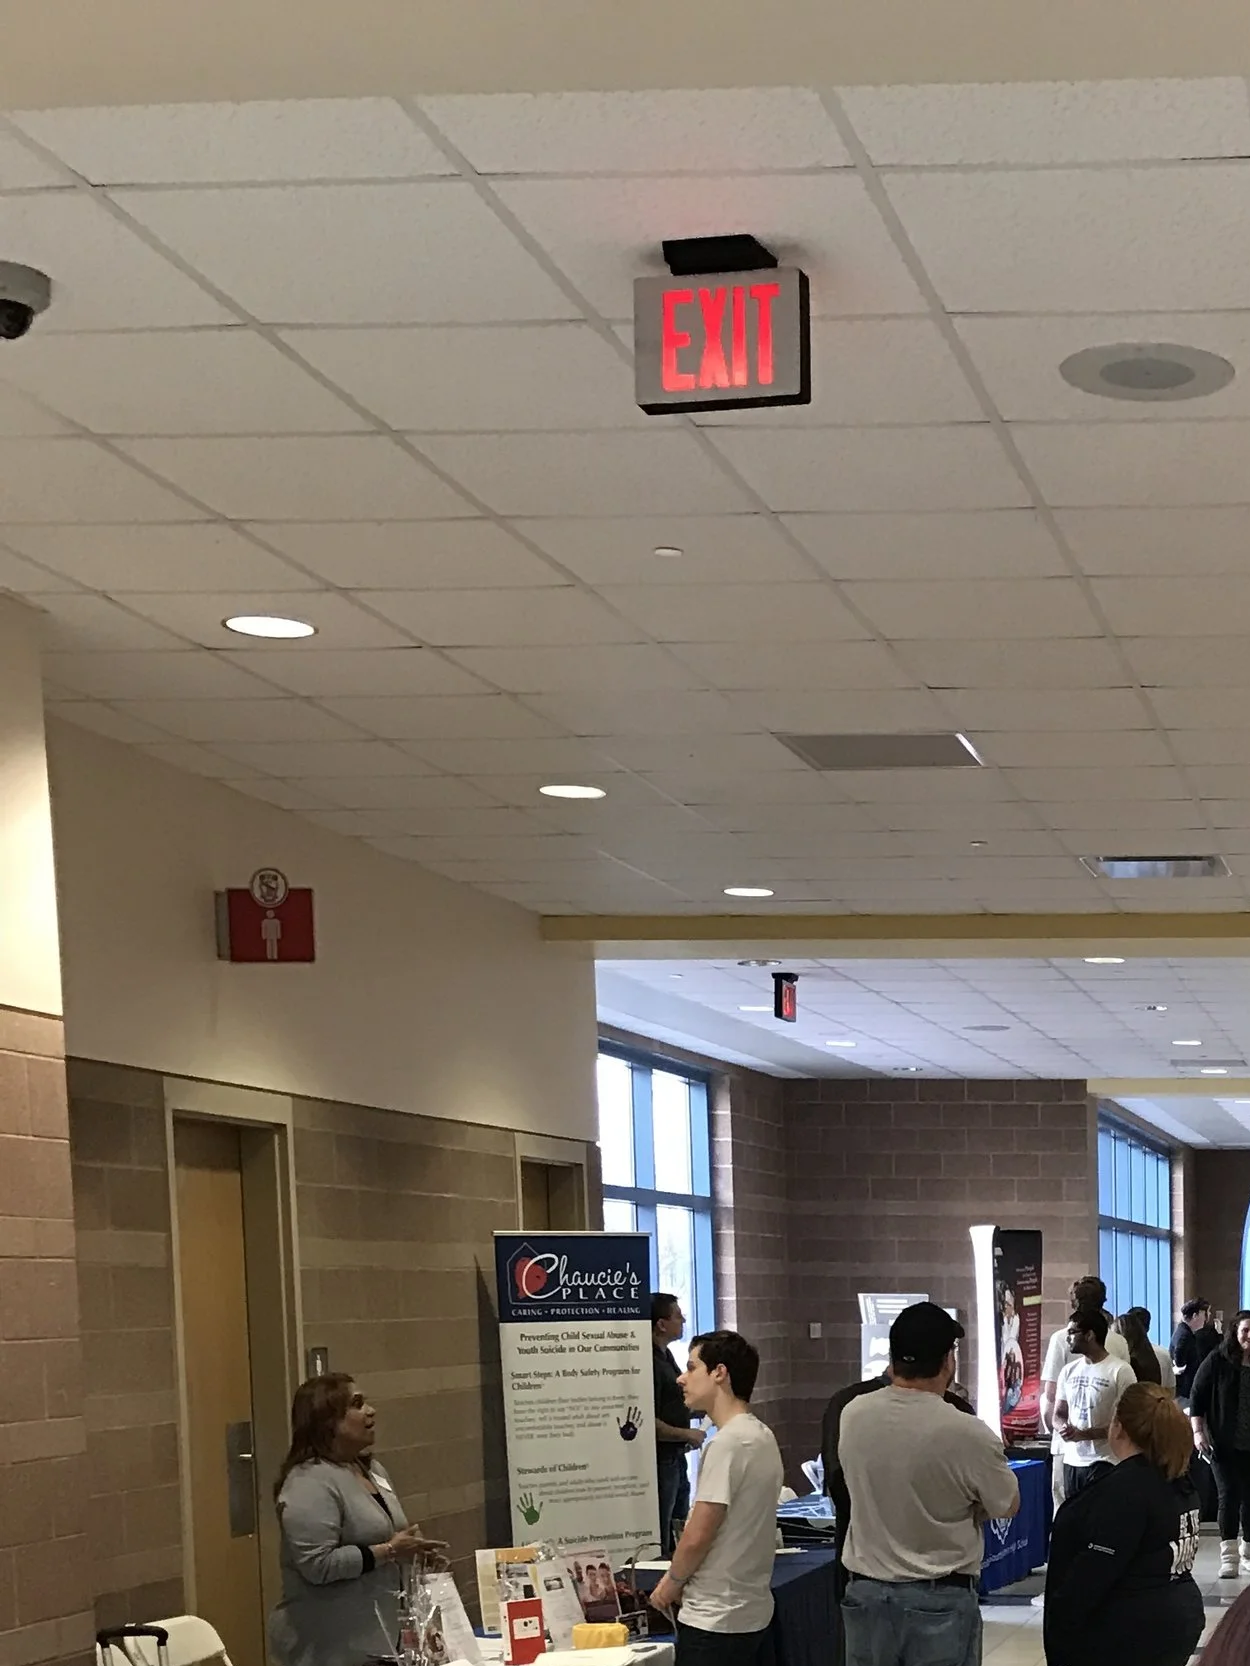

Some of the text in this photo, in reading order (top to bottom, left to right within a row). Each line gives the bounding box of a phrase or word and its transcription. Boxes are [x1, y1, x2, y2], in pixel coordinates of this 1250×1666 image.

[662, 283, 781, 393] EXIT
[522, 1253, 642, 1300] Chaucie's
[562, 1287, 640, 1301] PLACE
[511, 1308, 543, 1317] CARING
[550, 1307, 600, 1316] PROTECTION
[520, 1333, 560, 1343] Preventing
[561, 1331, 580, 1341] Child
[581, 1331, 605, 1341] Sexual
[607, 1331, 628, 1339] Abuse
[517, 1342, 640, 1355] Youth Suicide in Our Communities
